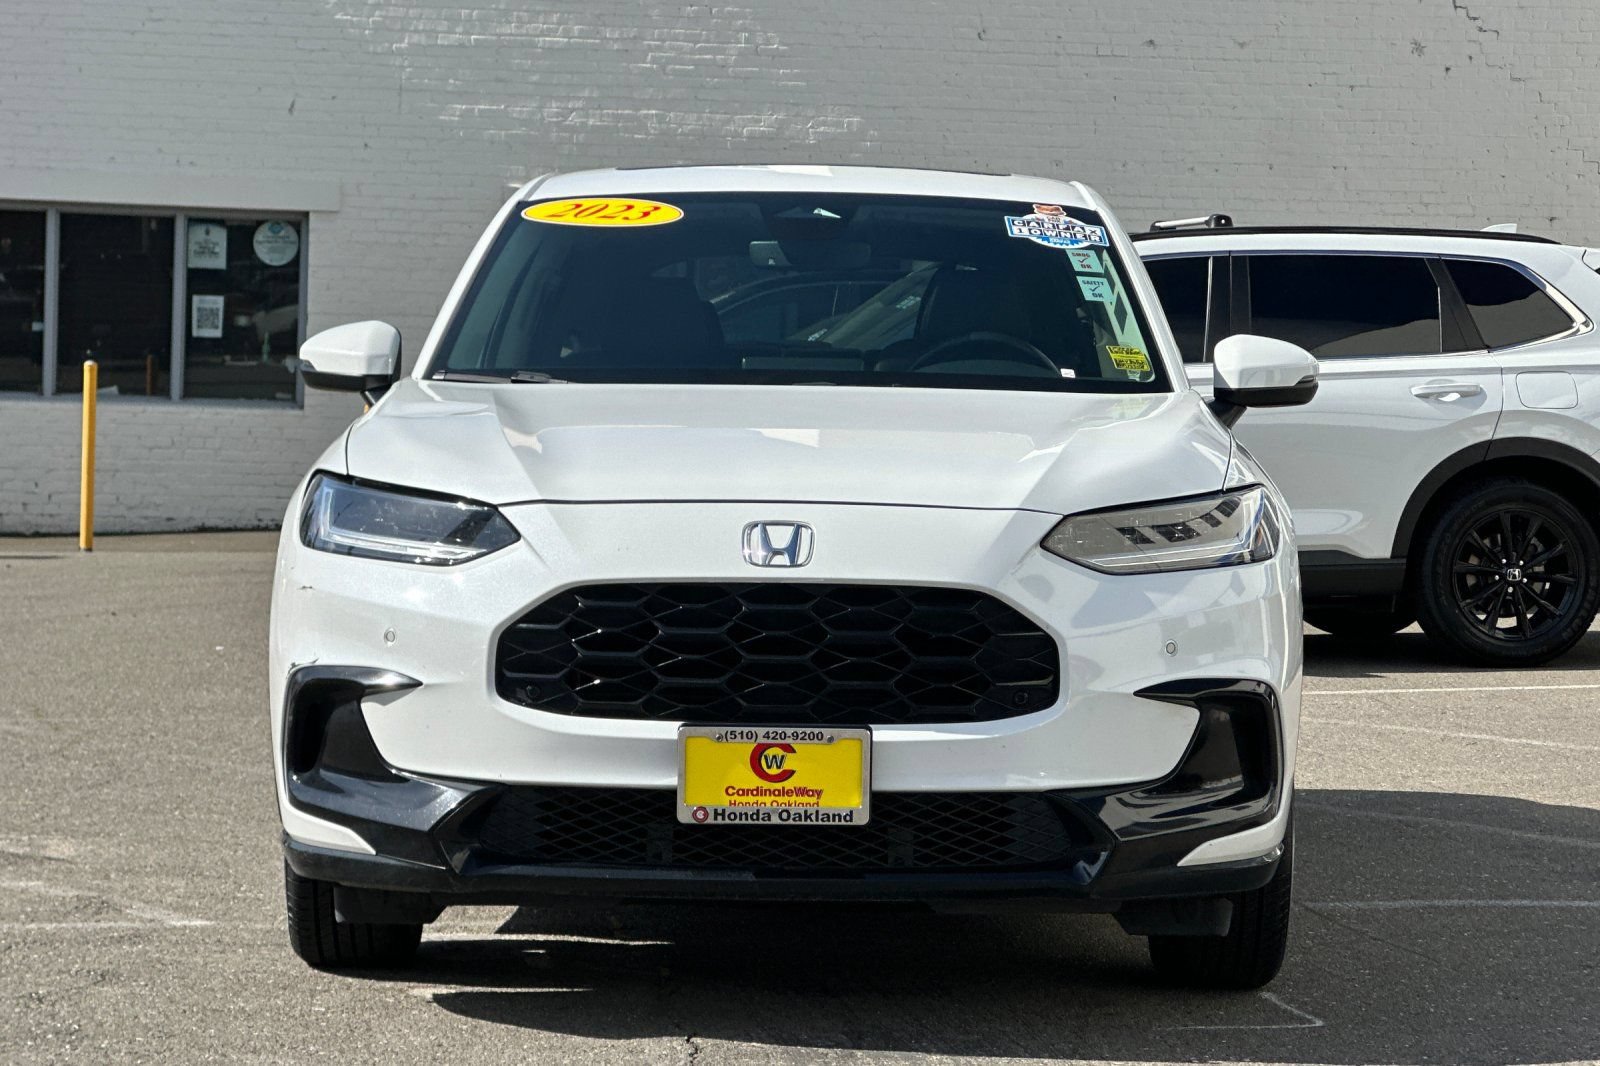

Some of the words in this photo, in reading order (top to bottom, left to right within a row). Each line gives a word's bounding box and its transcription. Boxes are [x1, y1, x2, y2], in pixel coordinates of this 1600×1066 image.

[546, 203, 661, 221] 2023
[1013, 219, 1098, 236] CARFAX
[724, 730, 758, 742] (510)
[762, 730, 824, 741] 420-9200
[724, 785, 824, 799] CardinaleWay
[713, 808, 772, 822] Honda
[778, 809, 854, 823] Oakland
